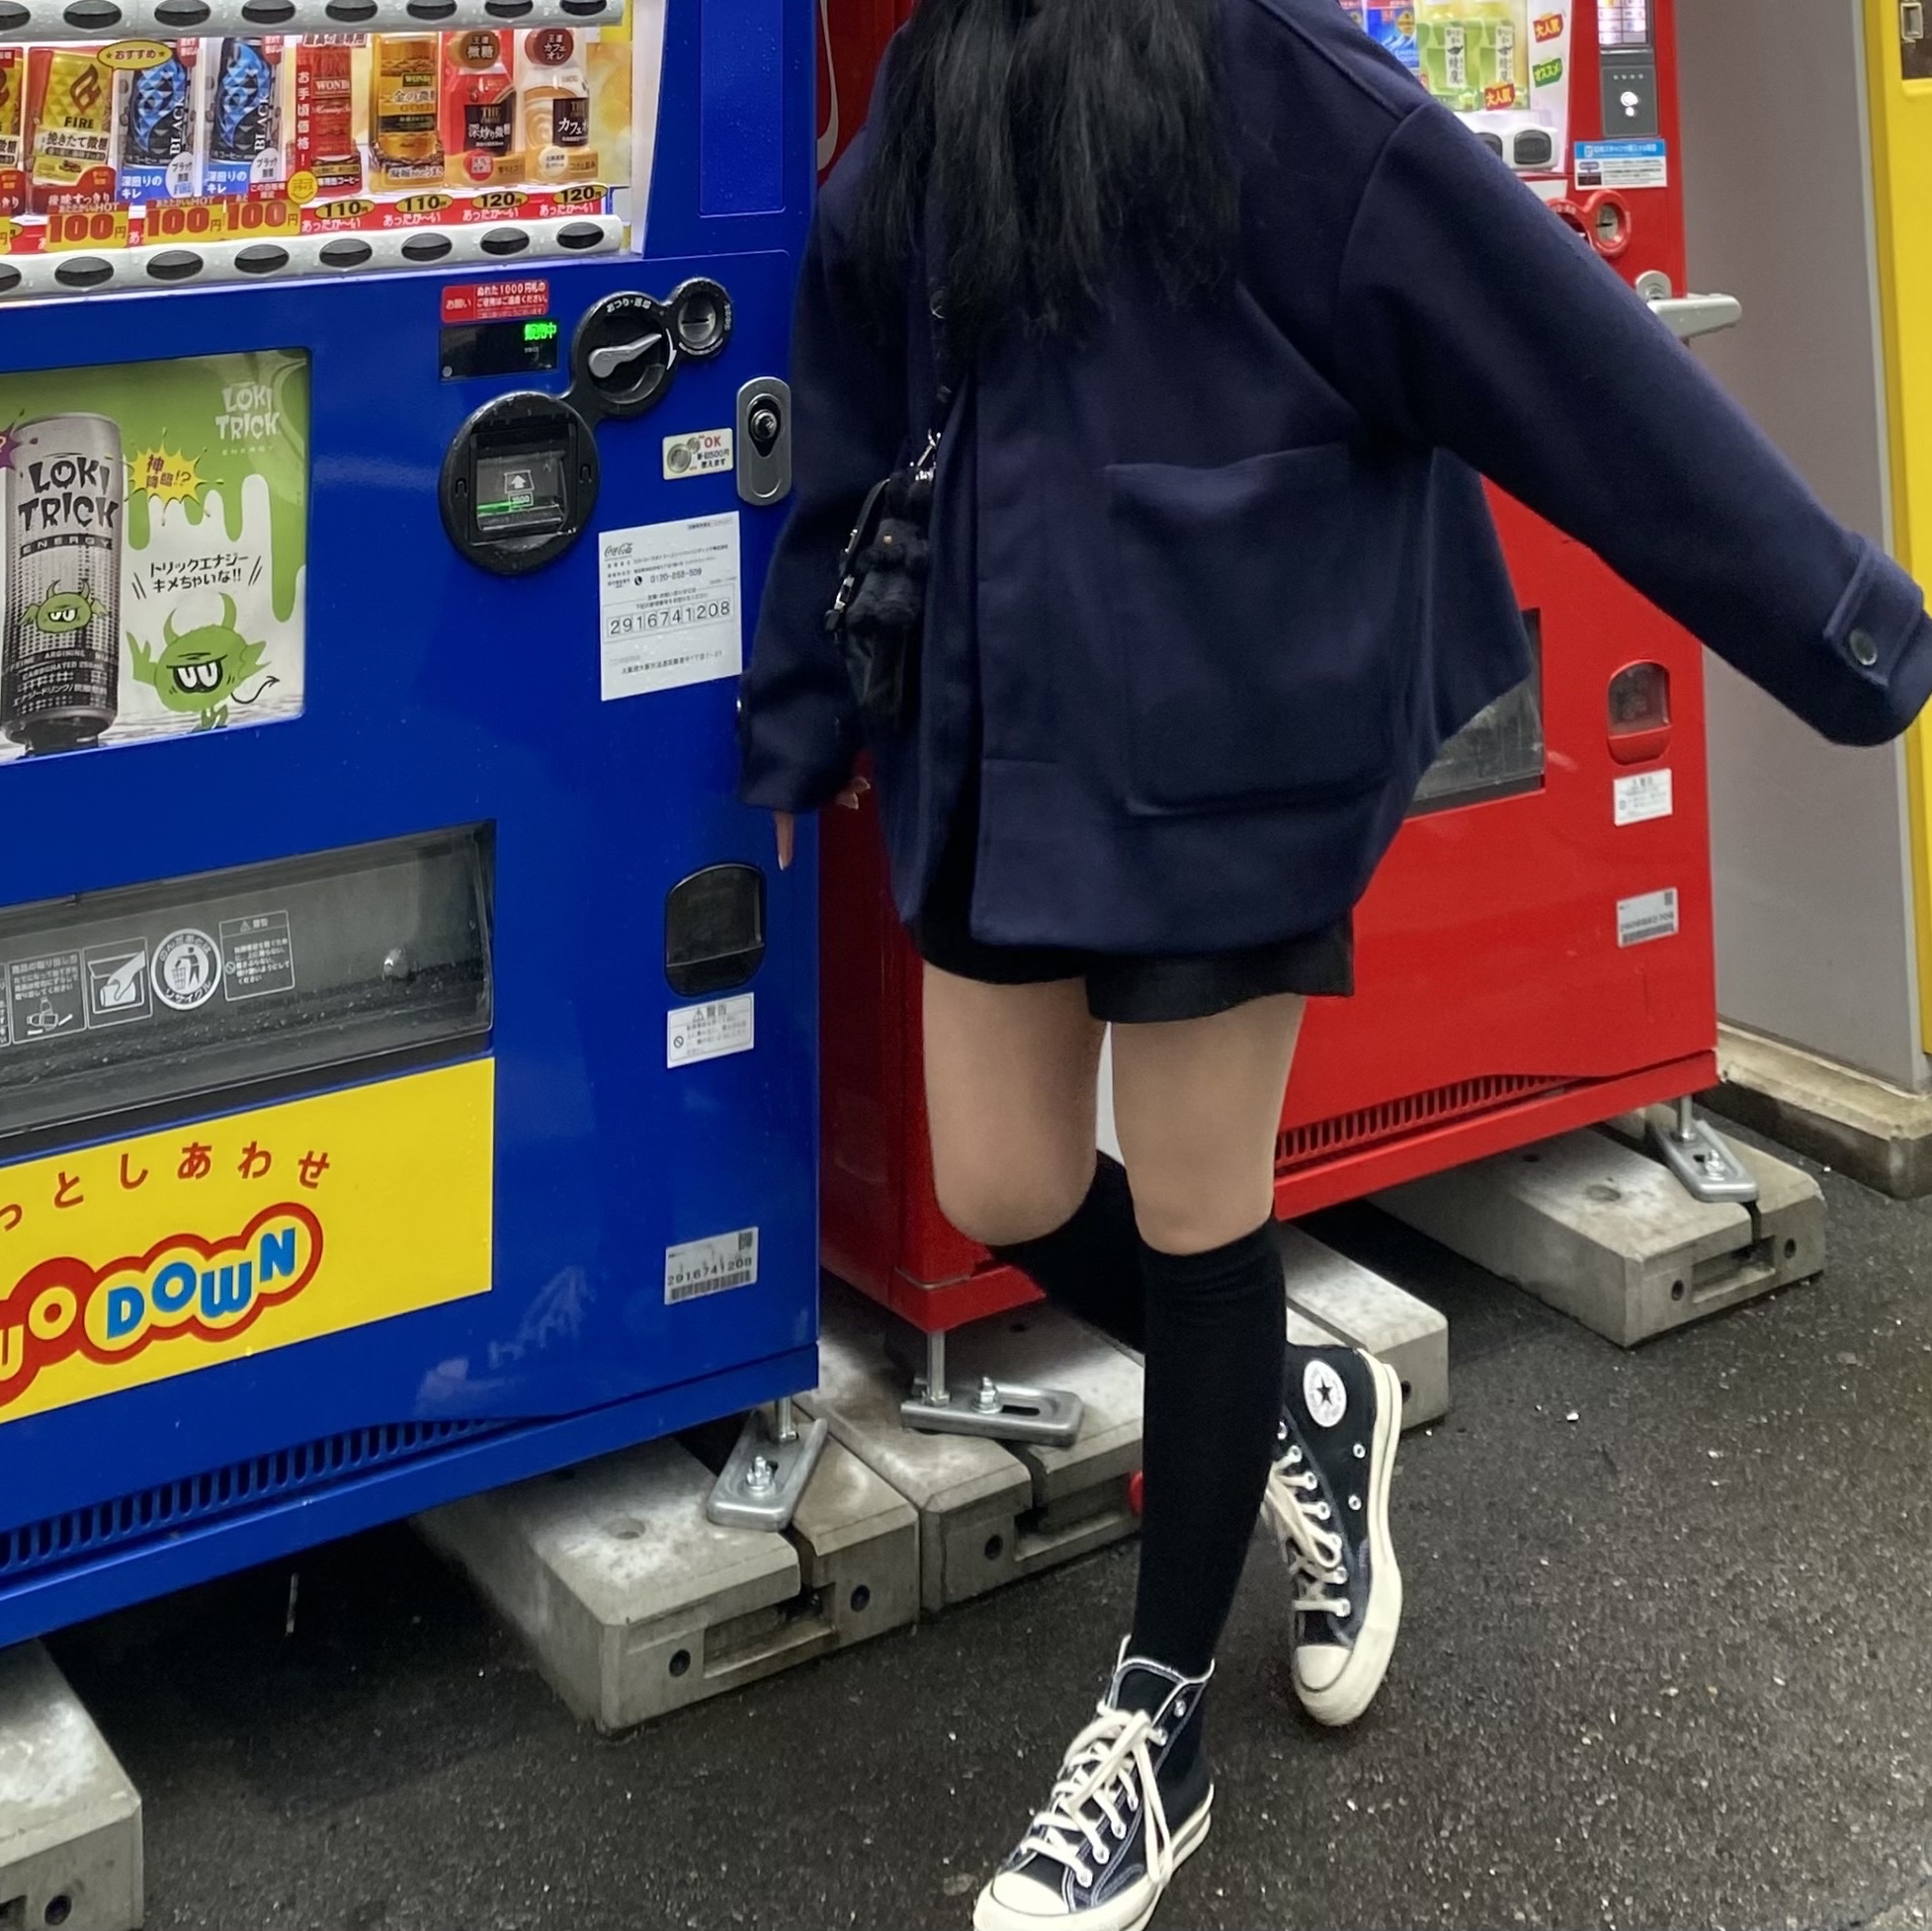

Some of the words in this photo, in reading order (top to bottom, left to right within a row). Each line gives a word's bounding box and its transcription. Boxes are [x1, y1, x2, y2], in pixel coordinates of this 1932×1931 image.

[115, 48, 156, 60] おすすめ
[467, 45, 494, 58] 微糖
[64, 117, 94, 129] FIRE
[122, 189, 141, 200] キレ
[207, 185, 227, 195] キレ
[96, 201, 121, 211] HOT
[191, 196, 213, 207] HOT
[446, 298, 471, 310] お願い
[221, 383, 273, 413] LOKI
[215, 412, 281, 443] TRICK
[704, 435, 722, 449] OK
[29, 455, 110, 493] LOKI
[146, 454, 164, 475] 神
[18, 491, 120, 533] TRICK
[21, 537, 114, 558] ENERGY
[150, 552, 249, 579] トリックエナジー
[610, 600, 730, 635] 2916741208
[12, 954, 78, 975] 商品の取り出し方
[164, 980, 212, 1004] リサイクル
[106, 1226, 296, 1341] DOWN
